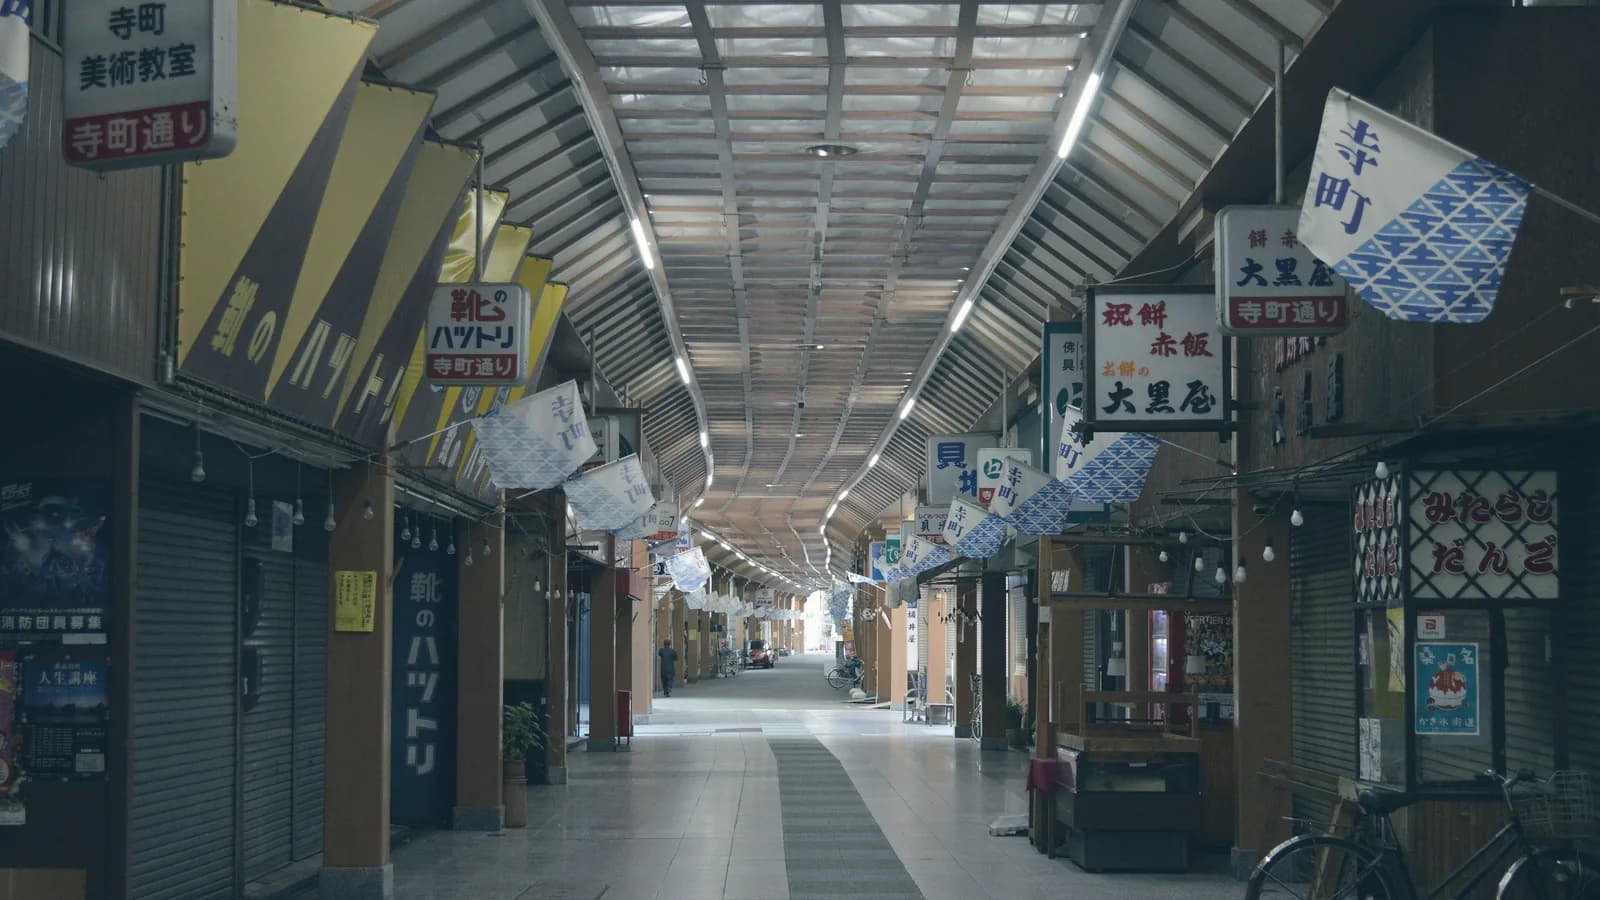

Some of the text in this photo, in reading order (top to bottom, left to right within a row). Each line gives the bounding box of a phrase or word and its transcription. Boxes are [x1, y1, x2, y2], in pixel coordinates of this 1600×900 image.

[108, 5, 166, 39] 寺町
[80, 43, 196, 91] 美術教室
[71, 111, 206, 158] 寺町通り
[1314, 119, 1382, 235] 寺町
[1248, 229, 1268, 248] 餅
[1236, 257, 1336, 287] 大黒屋
[451, 289, 507, 322] 靴の
[1102, 301, 1168, 330] 祝餅
[1238, 300, 1338, 323] 寺町通り
[1150, 332, 1214, 358] 赤飯
[433, 356, 512, 377] 寺町通り
[1103, 360, 1149, 378] お餅の
[1102, 379, 1217, 415] 大黒屋
[998, 466, 1022, 507] 寺町
[1423, 490, 1553, 525] みたらし
[1433, 534, 1557, 575] だんご
[39, 671, 97, 686] 人生講座
